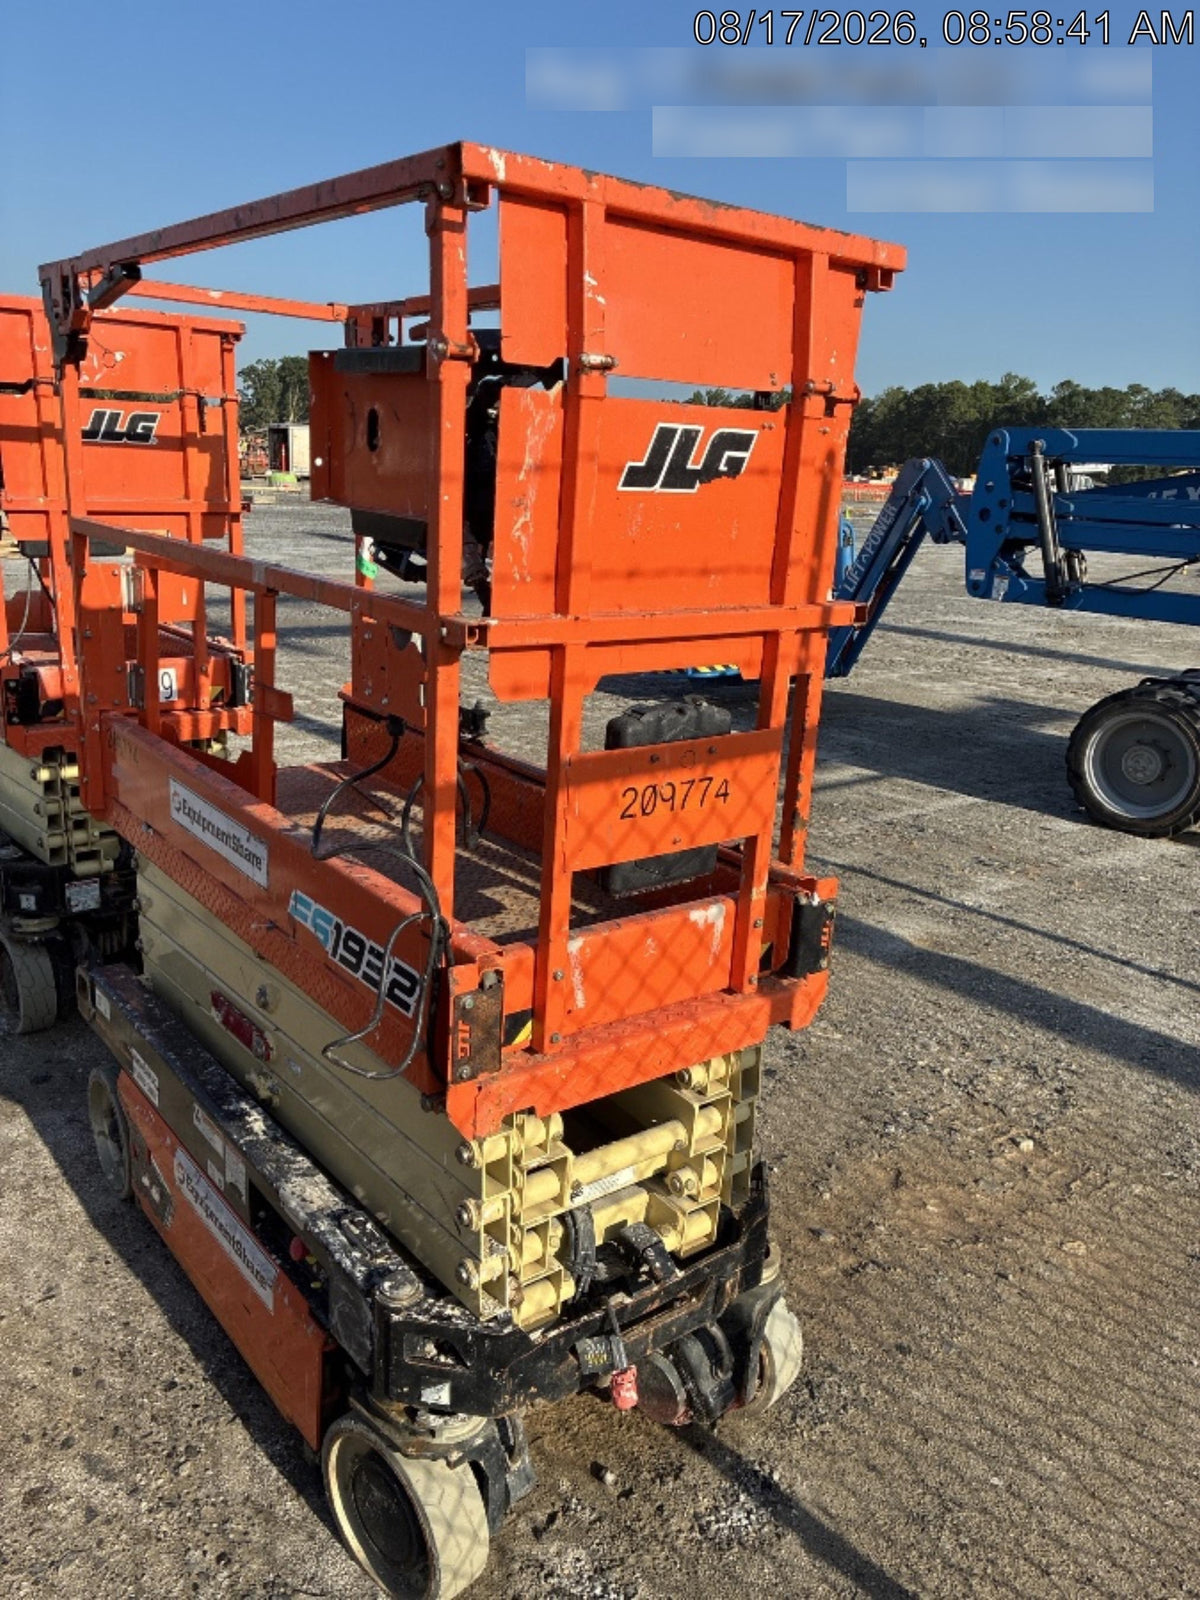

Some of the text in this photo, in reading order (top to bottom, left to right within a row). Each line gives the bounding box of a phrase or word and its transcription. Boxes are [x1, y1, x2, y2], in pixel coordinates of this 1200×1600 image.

[81, 408, 161, 444] JLG
[616, 422, 759, 493] JLG
[620, 776, 730, 820] 209774
[182, 797, 262, 872] EquipmentShare
[288, 889, 421, 1019] ES1932
[458, 1019, 470, 1060] JLG
